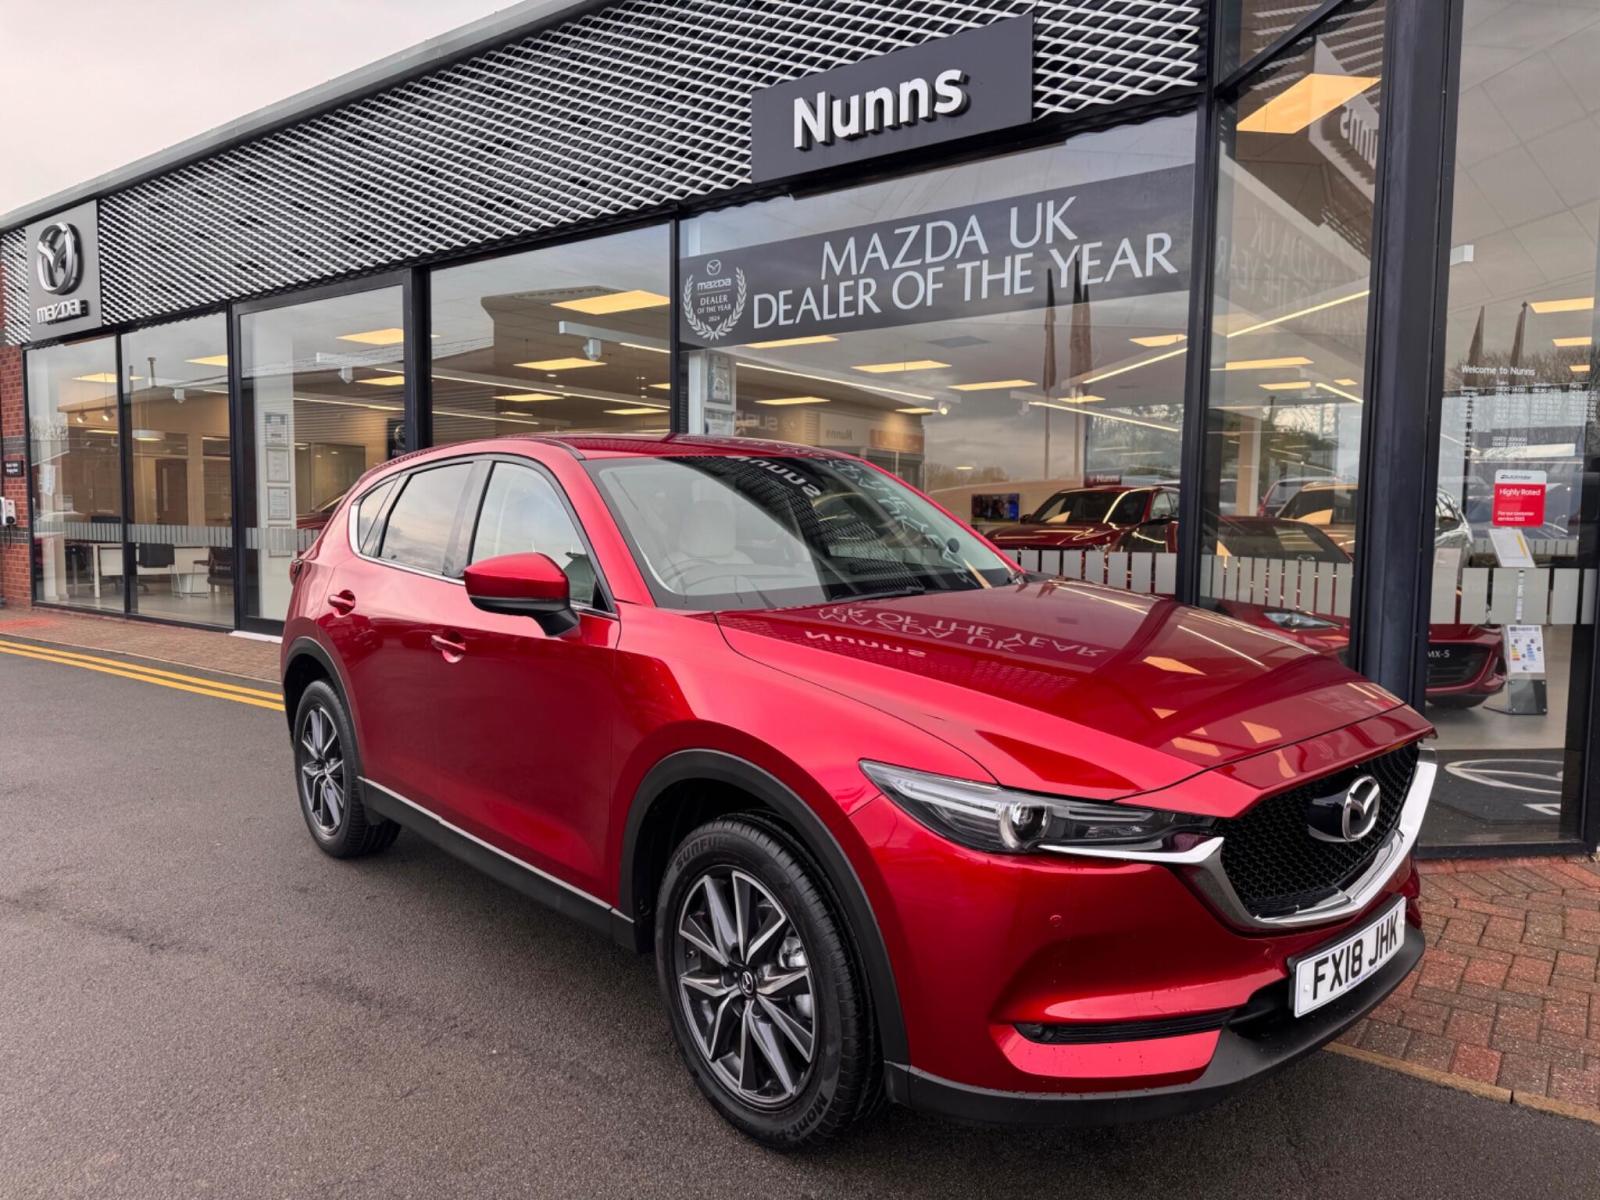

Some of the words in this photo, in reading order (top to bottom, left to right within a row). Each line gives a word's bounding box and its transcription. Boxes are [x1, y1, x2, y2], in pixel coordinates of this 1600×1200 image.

[793, 69, 964, 149] Nunns
[820, 214, 989, 280] MAZDA
[1010, 196, 1078, 249] UK
[697, 278, 731, 290] mazda
[753, 278, 882, 329] DEALER
[892, 266, 945, 310] OF
[957, 252, 1035, 301] THE
[1049, 232, 1178, 288] YEAR
[700, 294, 728, 306] DEALER
[706, 304, 716, 313] THE
[717, 303, 731, 311] YEAR
[36, 298, 83, 323] mazda
[1462, 365, 1497, 375] Welcome
[1499, 366, 1508, 375] to
[1510, 367, 1535, 376] Nunns
[1499, 488, 1520, 497] Highly
[1521, 488, 1541, 496] Rated
[1313, 938, 1363, 1000] FX18
[1368, 911, 1399, 967] JHK
